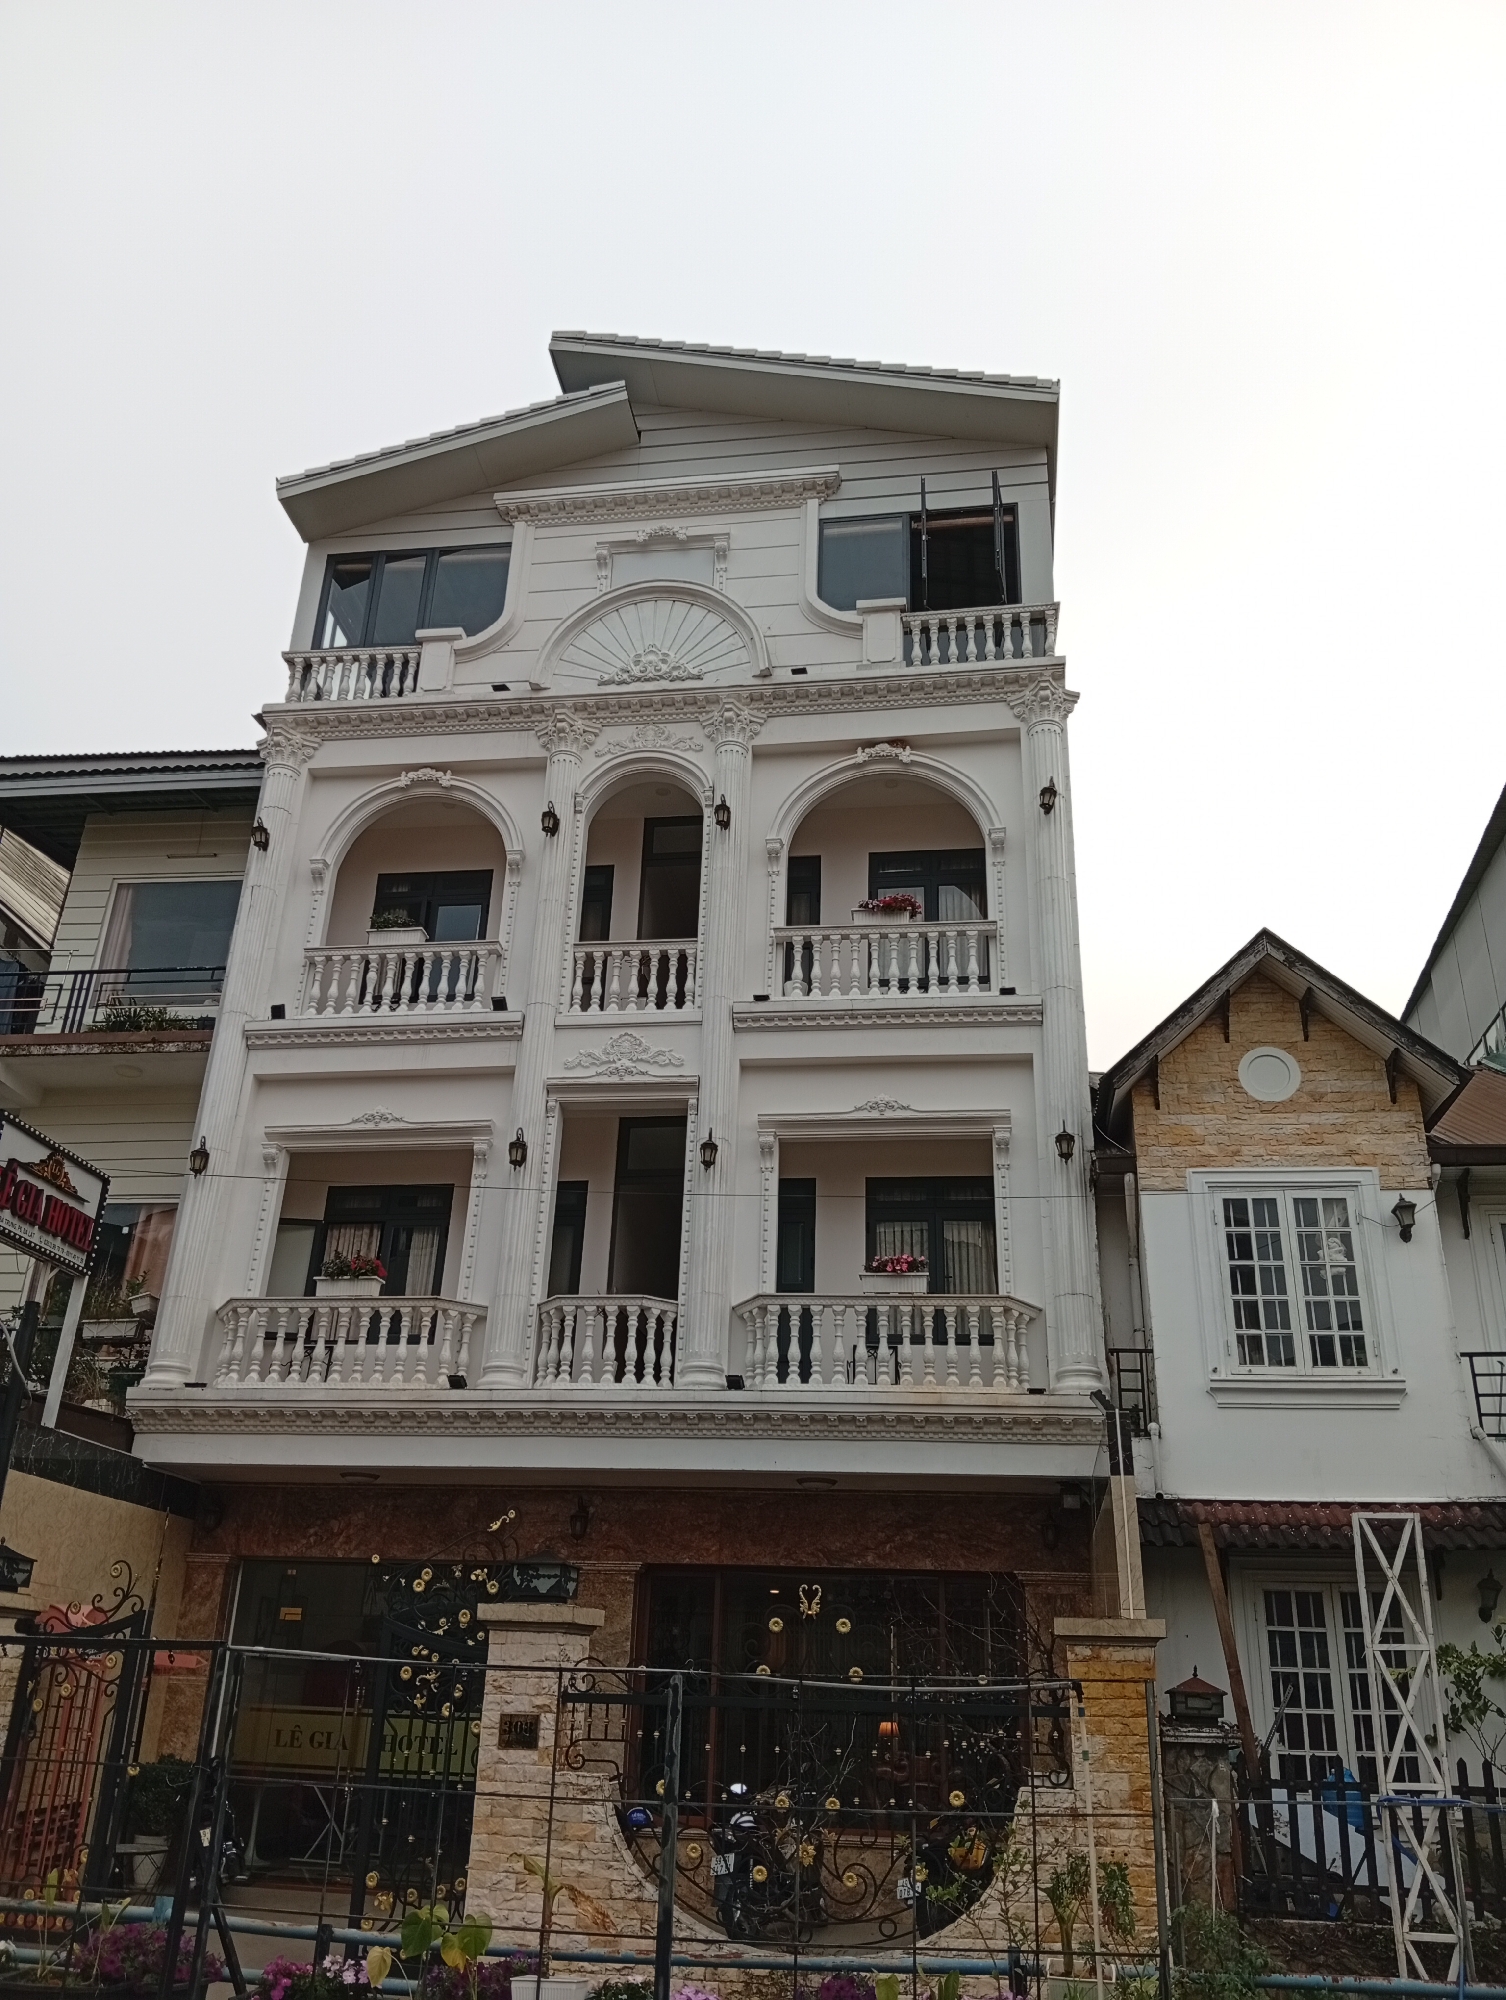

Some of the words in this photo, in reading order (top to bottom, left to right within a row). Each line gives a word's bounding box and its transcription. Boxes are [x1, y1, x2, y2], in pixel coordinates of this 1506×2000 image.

[17, 1181, 44, 1225] GIA
[45, 1198, 95, 1252] HOTEL
[274, 1724, 303, 1748] LÊ
[309, 1731, 350, 1750] GIA
